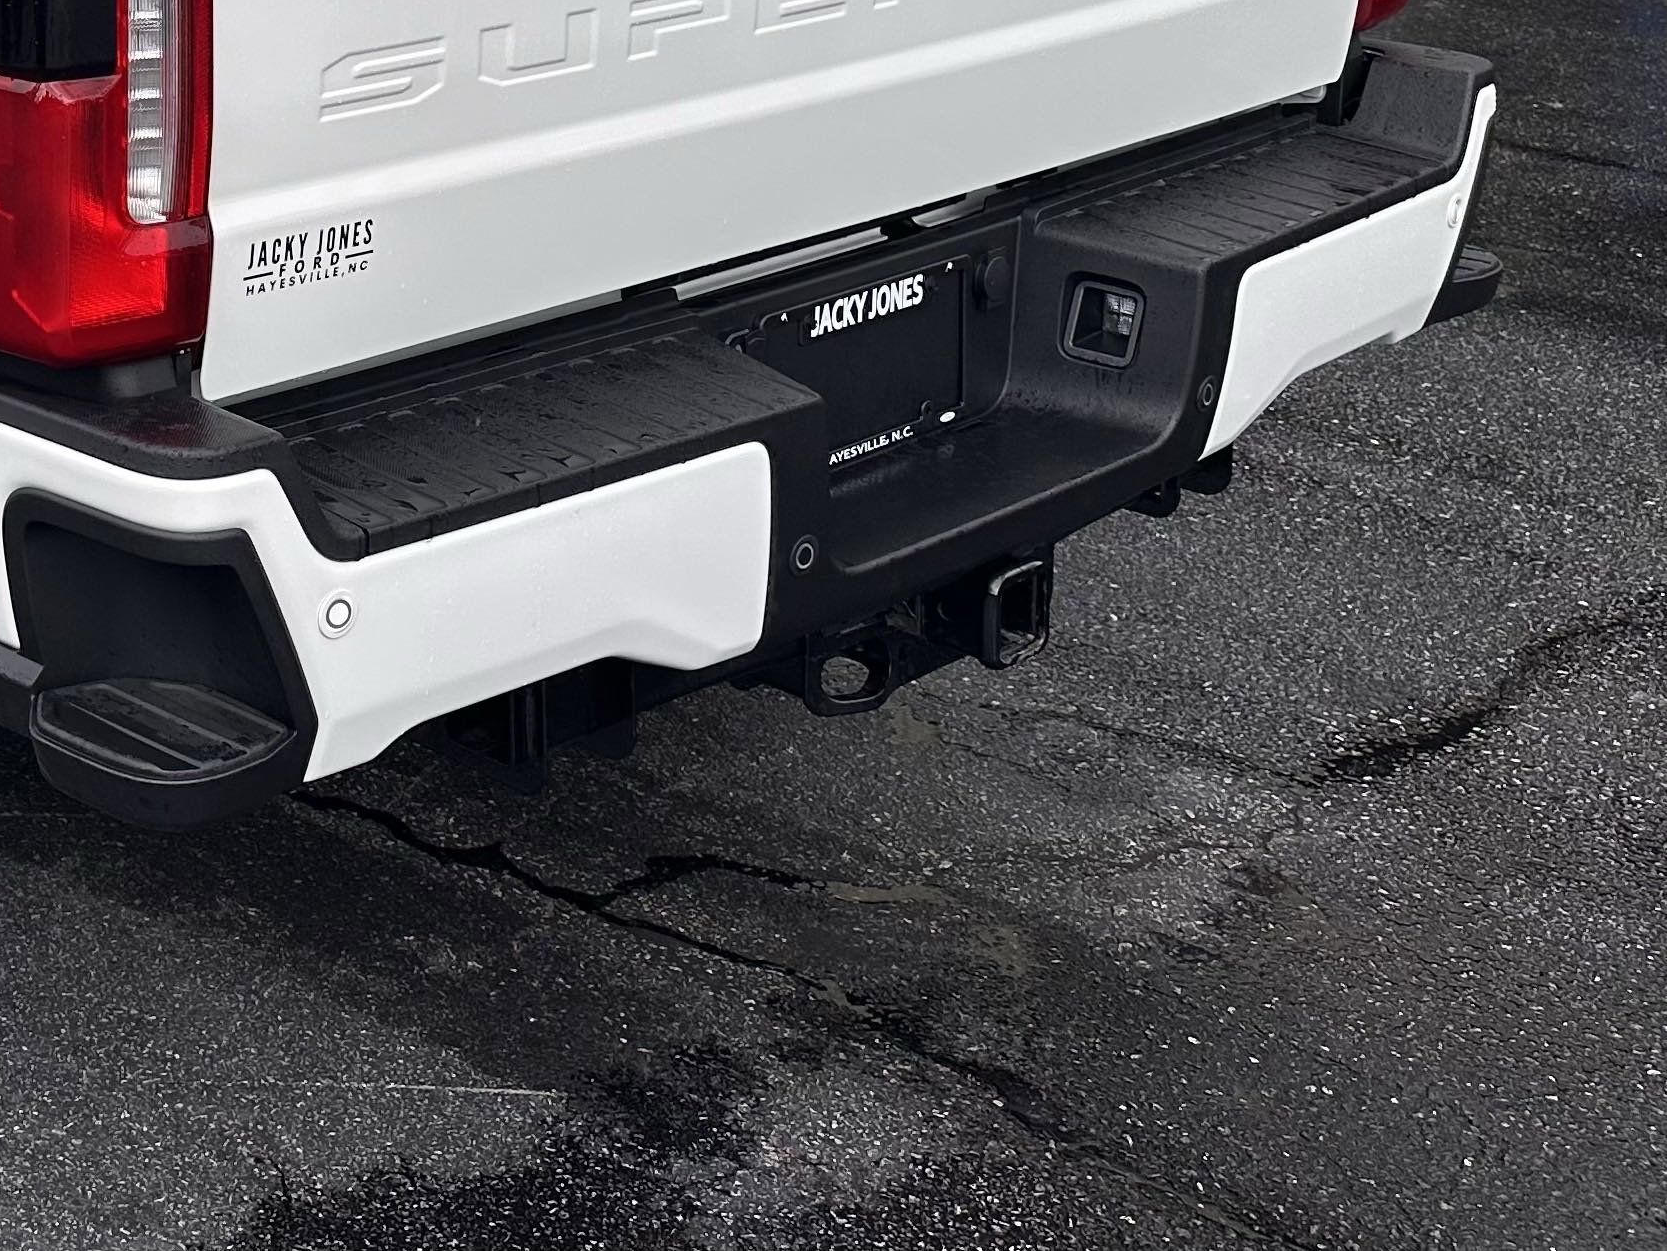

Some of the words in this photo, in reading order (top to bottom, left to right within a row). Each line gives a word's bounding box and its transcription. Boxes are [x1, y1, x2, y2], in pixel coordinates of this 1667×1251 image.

[247, 232, 308, 270] JACKY
[317, 219, 373, 254] JONES
[279, 252, 340, 278] FORD
[810, 291, 868, 338] JACKY
[868, 273, 924, 320] JONES
[828, 435, 890, 466] AYESVILLE,
[891, 425, 914, 443] N.C.
